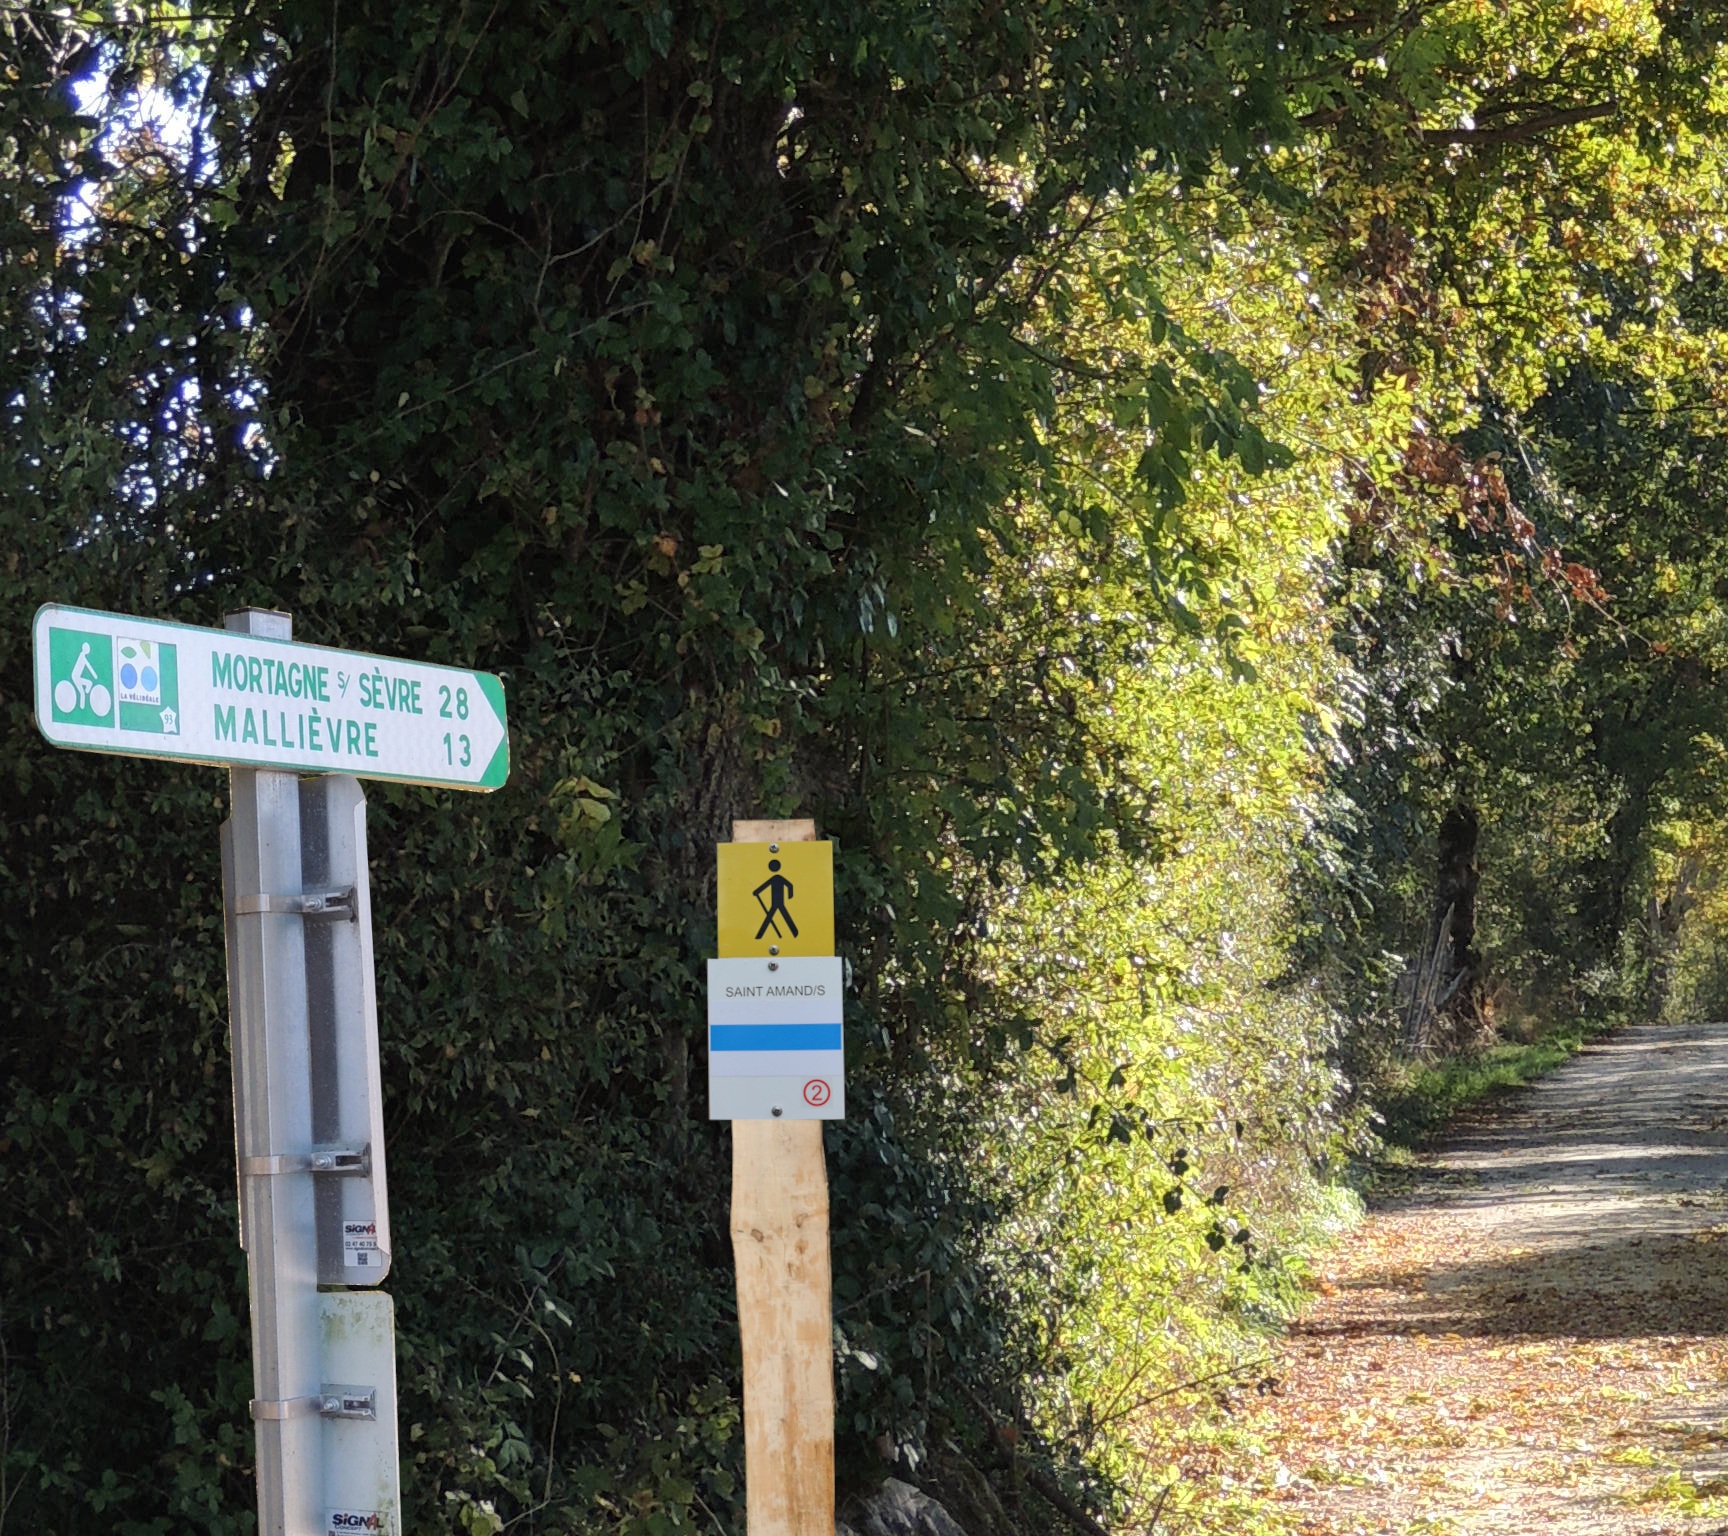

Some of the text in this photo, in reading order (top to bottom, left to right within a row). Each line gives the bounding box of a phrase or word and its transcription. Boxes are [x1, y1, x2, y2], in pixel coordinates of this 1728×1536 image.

[211, 651, 331, 703] MORTAGNE
[359, 666, 423, 715] SÈVRE
[438, 684, 469, 721] 28
[120, 692, 160, 704] LA VÉLIDÉALE
[164, 714, 173, 725] 93
[213, 703, 472, 767] MALLIÈVRE 13
[725, 985, 826, 998] SAINT AMAND/S
[811, 1084, 823, 1102] 2
